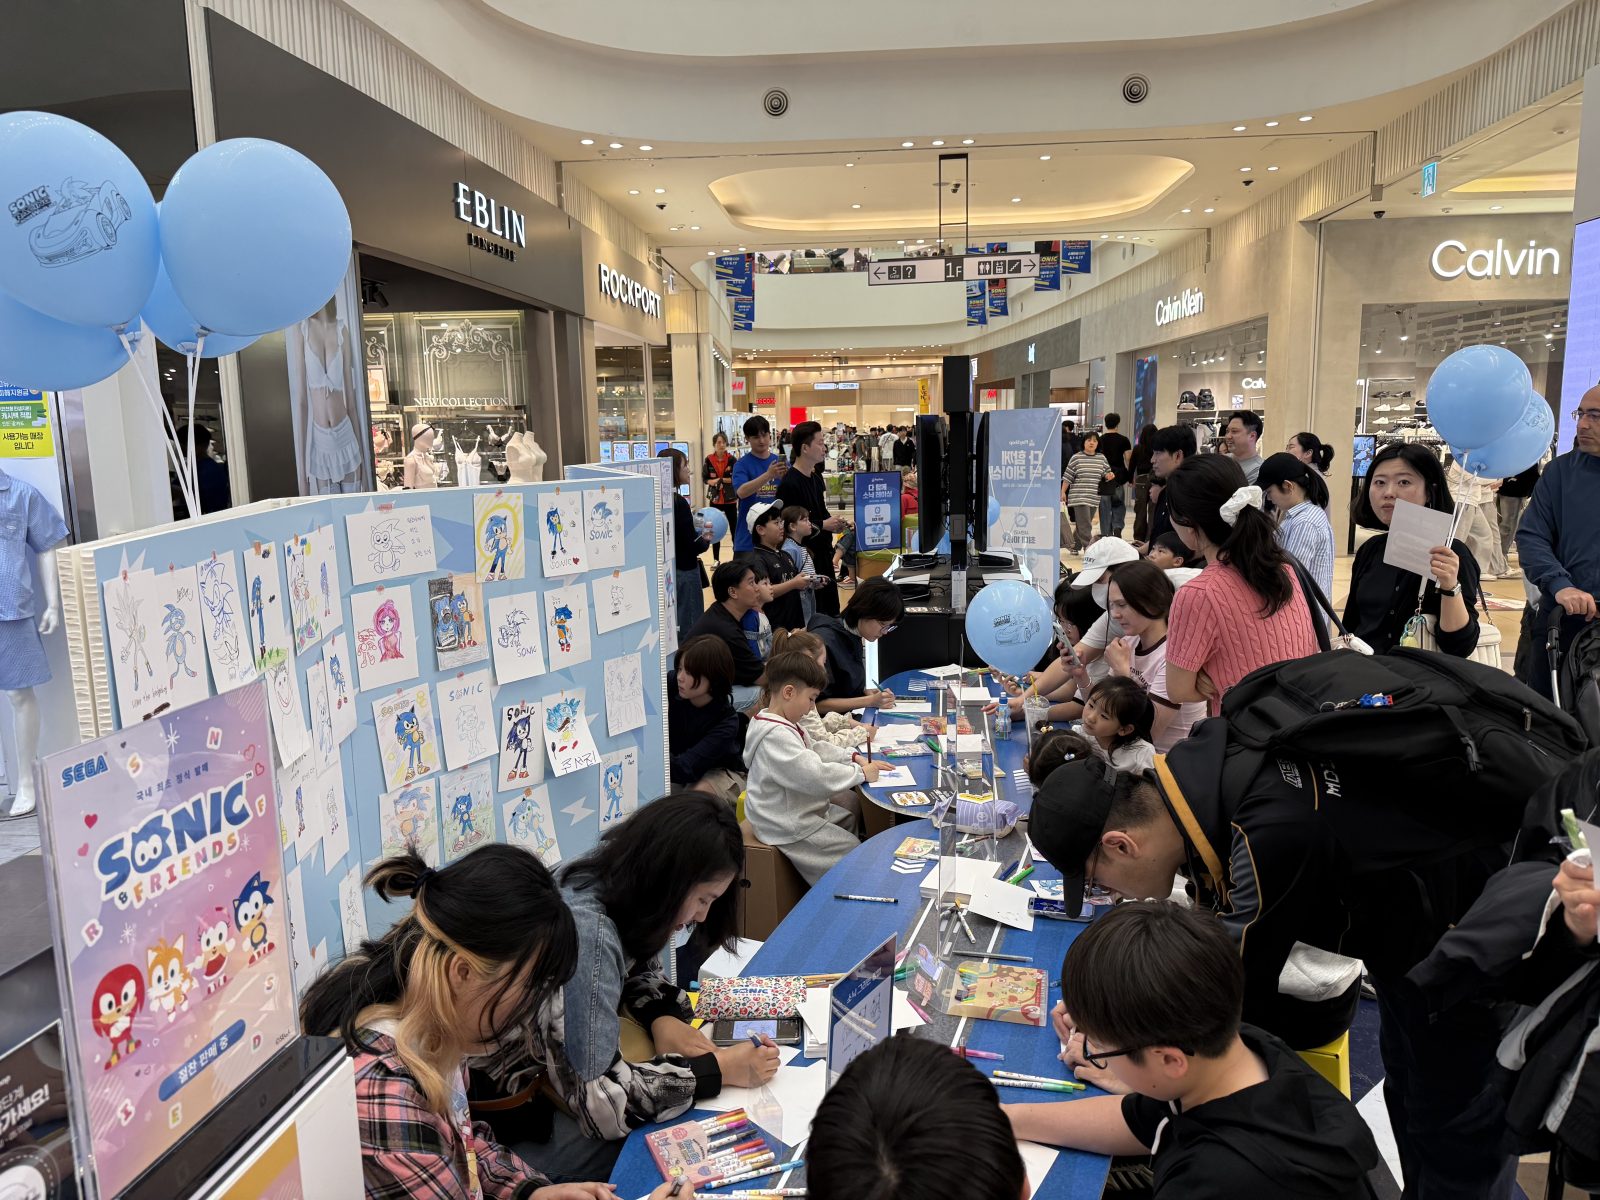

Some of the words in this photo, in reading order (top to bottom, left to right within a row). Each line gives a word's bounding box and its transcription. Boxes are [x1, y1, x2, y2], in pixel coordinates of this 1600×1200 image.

[455, 181, 526, 248] EBLIN
[1431, 239, 1560, 278] Calvin
[599, 263, 662, 319] ROCKPORT
[1155, 296, 1182, 327] Calvin
[1181, 287, 1204, 319] Klein
[414, 397, 439, 407] NEW
[441, 397, 509, 408] COLLECTION
[3, 431, 28, 441] 사용가능
[14, 442, 35, 451] 입니다
[590, 529, 613, 541] SONIC
[61, 754, 109, 788] SEGA
[136, 787, 153, 801] 국내
[199, 1042, 218, 1067] 판매
[0, 1084, 25, 1114] 단계
[0, 1083, 50, 1136] 가세요!
